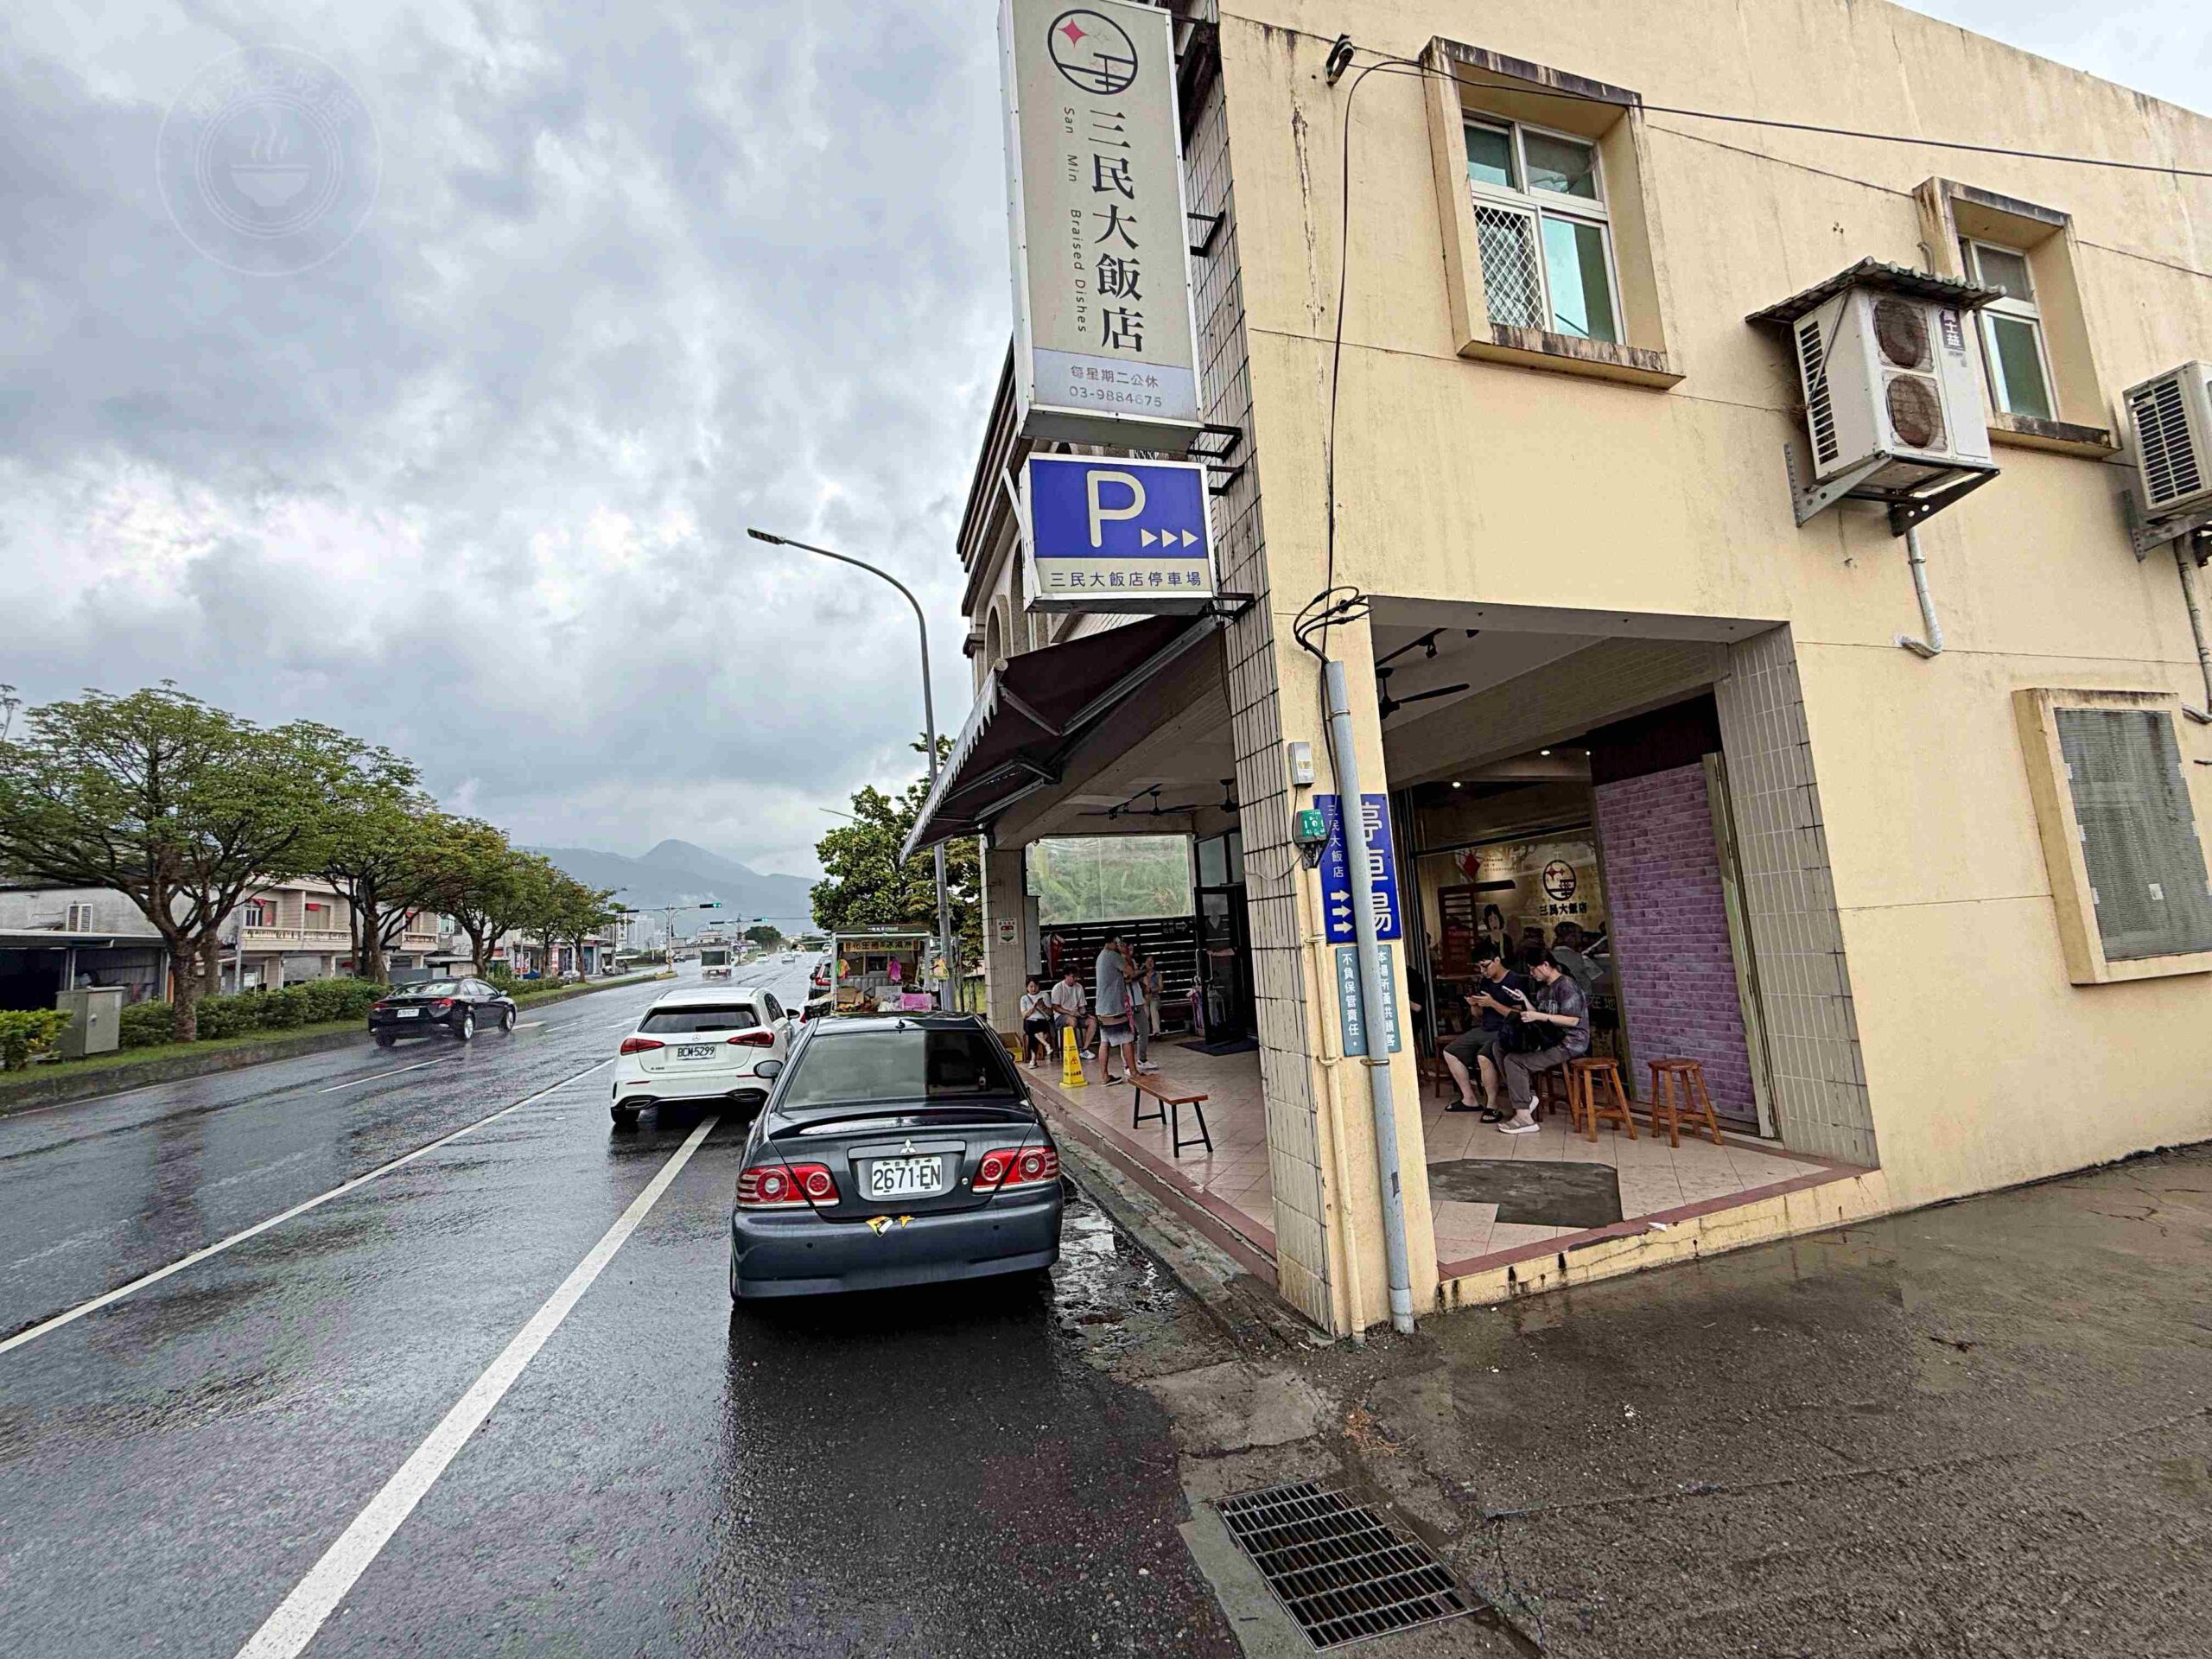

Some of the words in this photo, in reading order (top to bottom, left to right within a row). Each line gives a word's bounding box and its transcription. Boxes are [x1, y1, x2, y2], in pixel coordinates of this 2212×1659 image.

[1064, 106, 1076, 134] San
[1066, 154, 1078, 182] Min
[1071, 209, 1086, 271] Braised
[1088, 109, 1145, 353] 三民大飯店
[1074, 272, 1088, 334] Dishes
[1069, 385, 1163, 408] 03-9884675
[1070, 365, 1159, 389] 每星期二公休
[1086, 469, 1146, 548] P
[1050, 571, 1202, 588] 三民大飯店停車場
[1326, 804, 1344, 879] 三民大飯店
